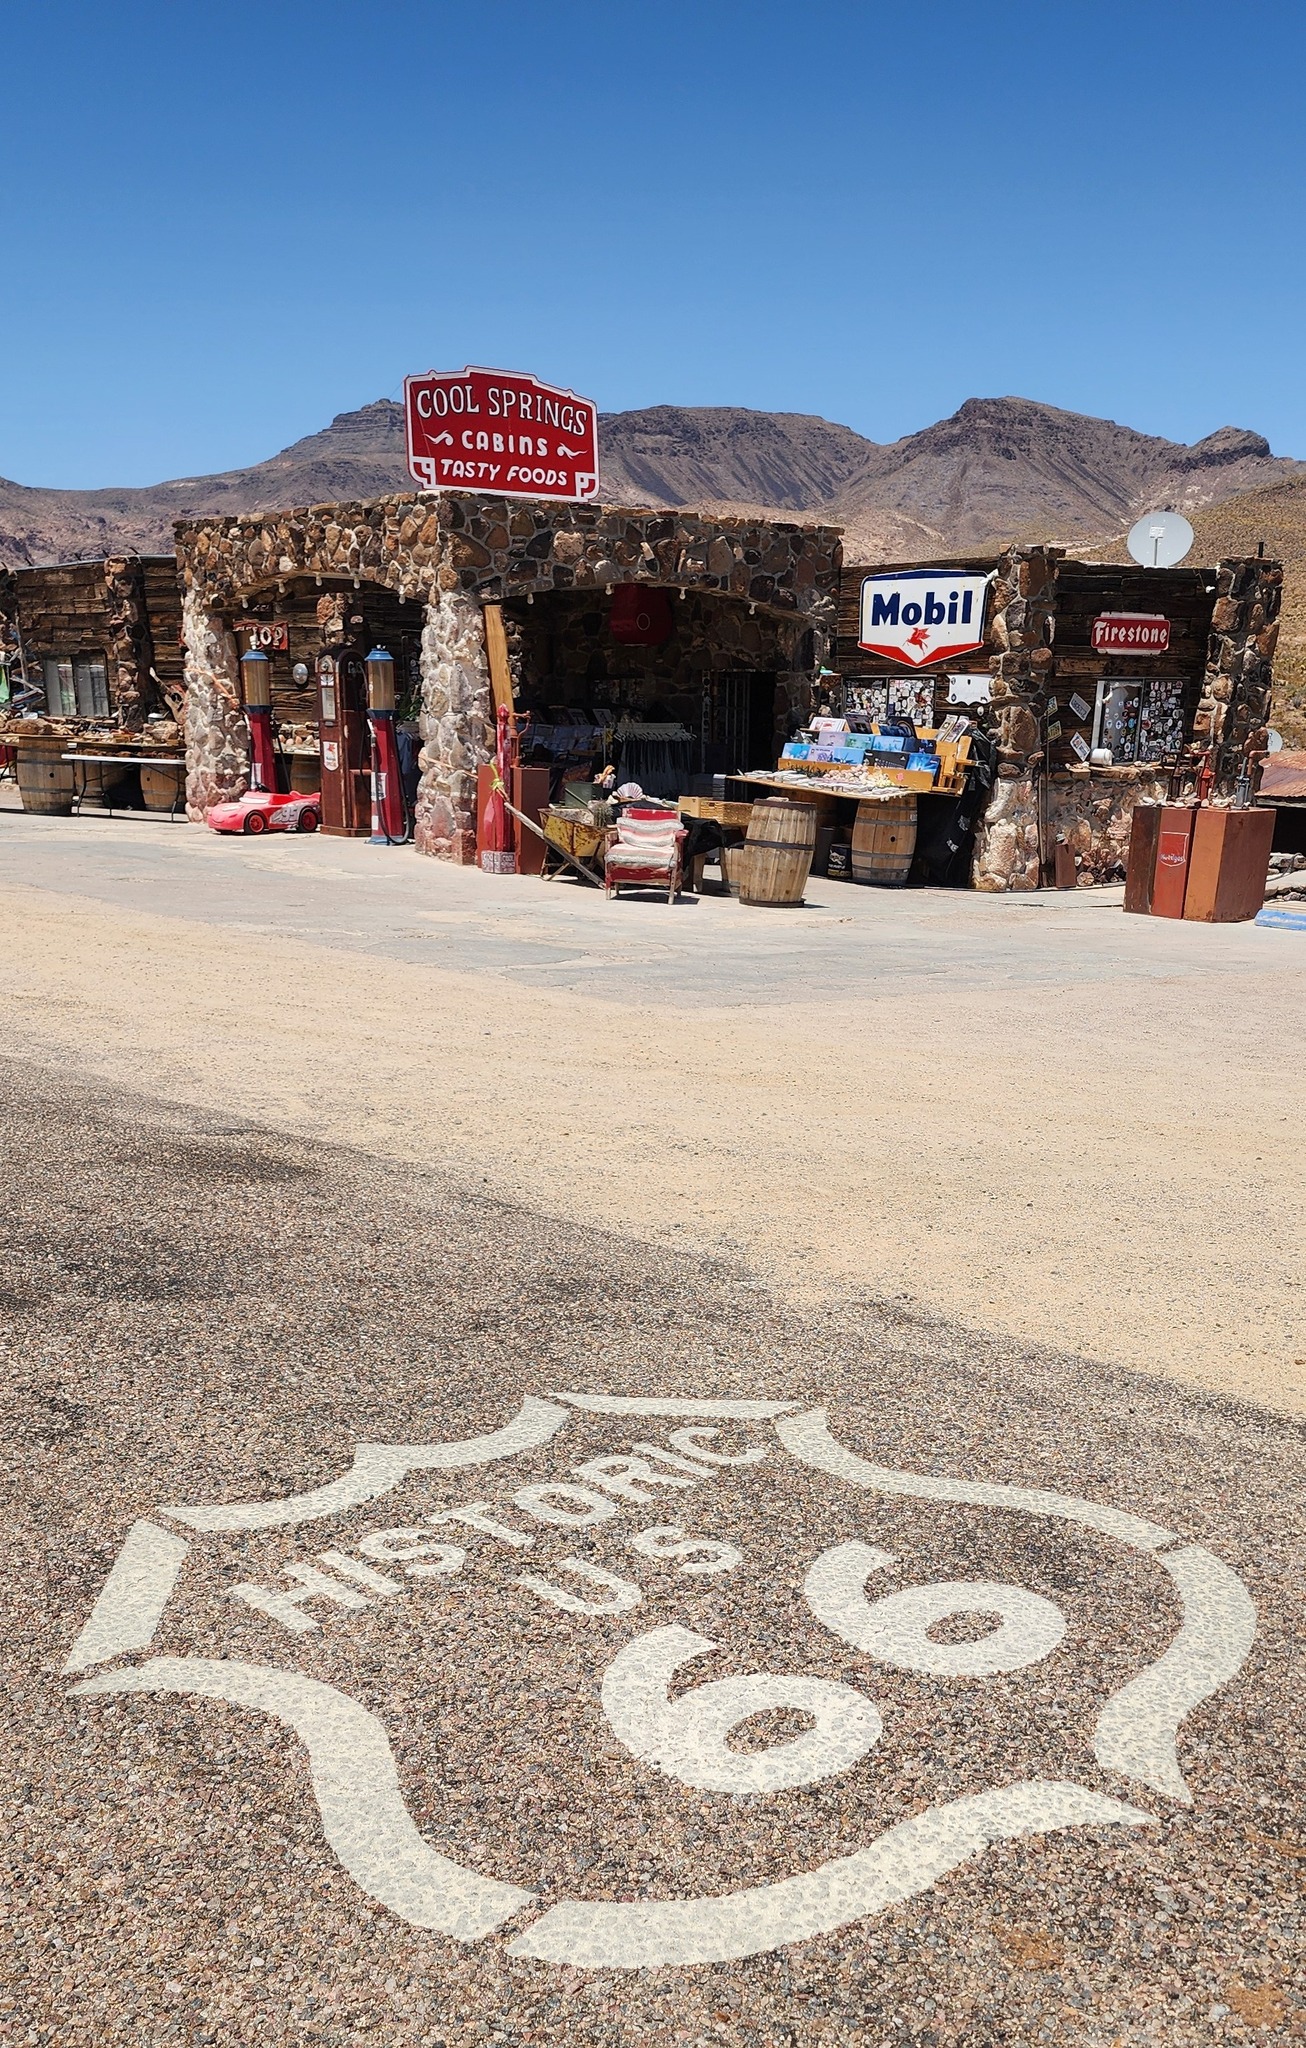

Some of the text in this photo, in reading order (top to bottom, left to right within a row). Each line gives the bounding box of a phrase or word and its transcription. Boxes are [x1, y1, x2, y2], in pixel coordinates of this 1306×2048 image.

[416, 385, 587, 436] COOL SPRINGS
[461, 430, 548, 457] CABINS
[440, 459, 568, 486] TASTY FOODS
[871, 590, 973, 626] Mobil
[1094, 621, 1168, 645] Firestone
[228, 1427, 766, 1634] HISTORIC
[514, 1526, 744, 1616] US
[601, 1540, 1068, 1794] 66
